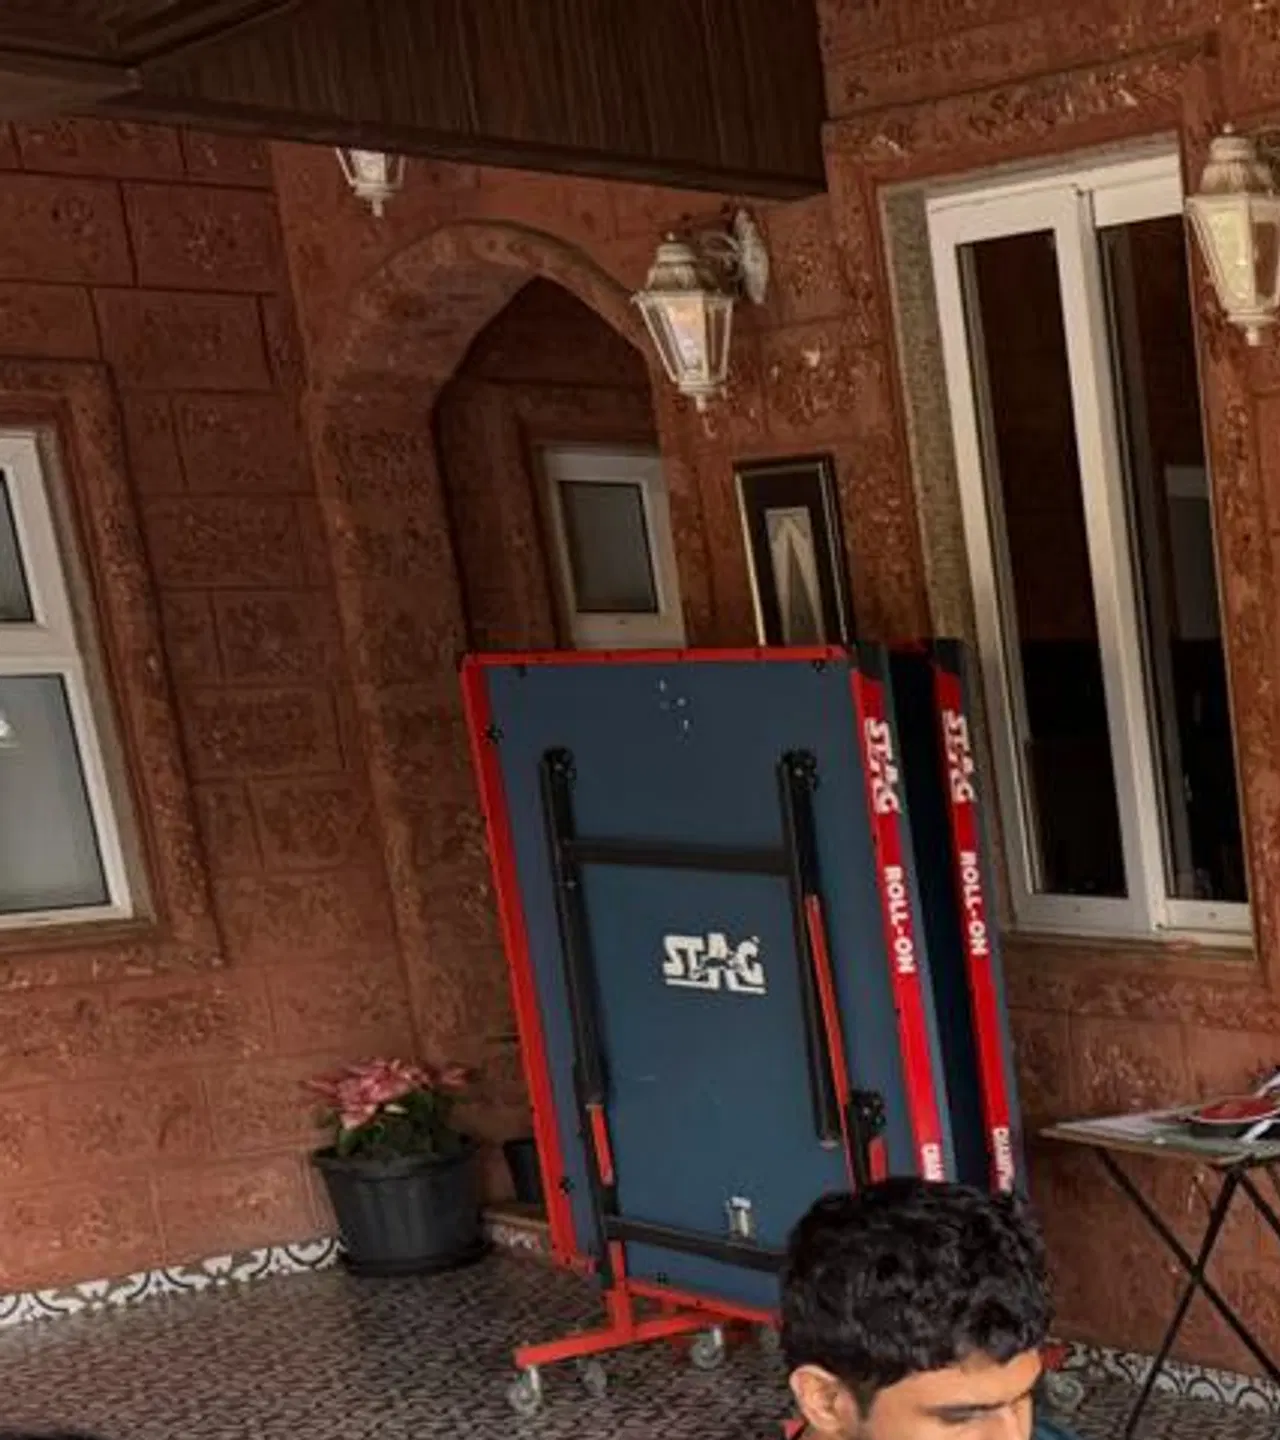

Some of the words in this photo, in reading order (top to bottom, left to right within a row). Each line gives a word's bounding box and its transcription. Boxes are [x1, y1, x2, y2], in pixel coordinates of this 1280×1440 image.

[864, 717, 901, 814] STAG
[884, 866, 917, 974] ROLL-ON
[942, 710, 976, 803] STAG
[959, 851, 989, 956] ROLL-ON
[663, 932, 767, 994] STAG
